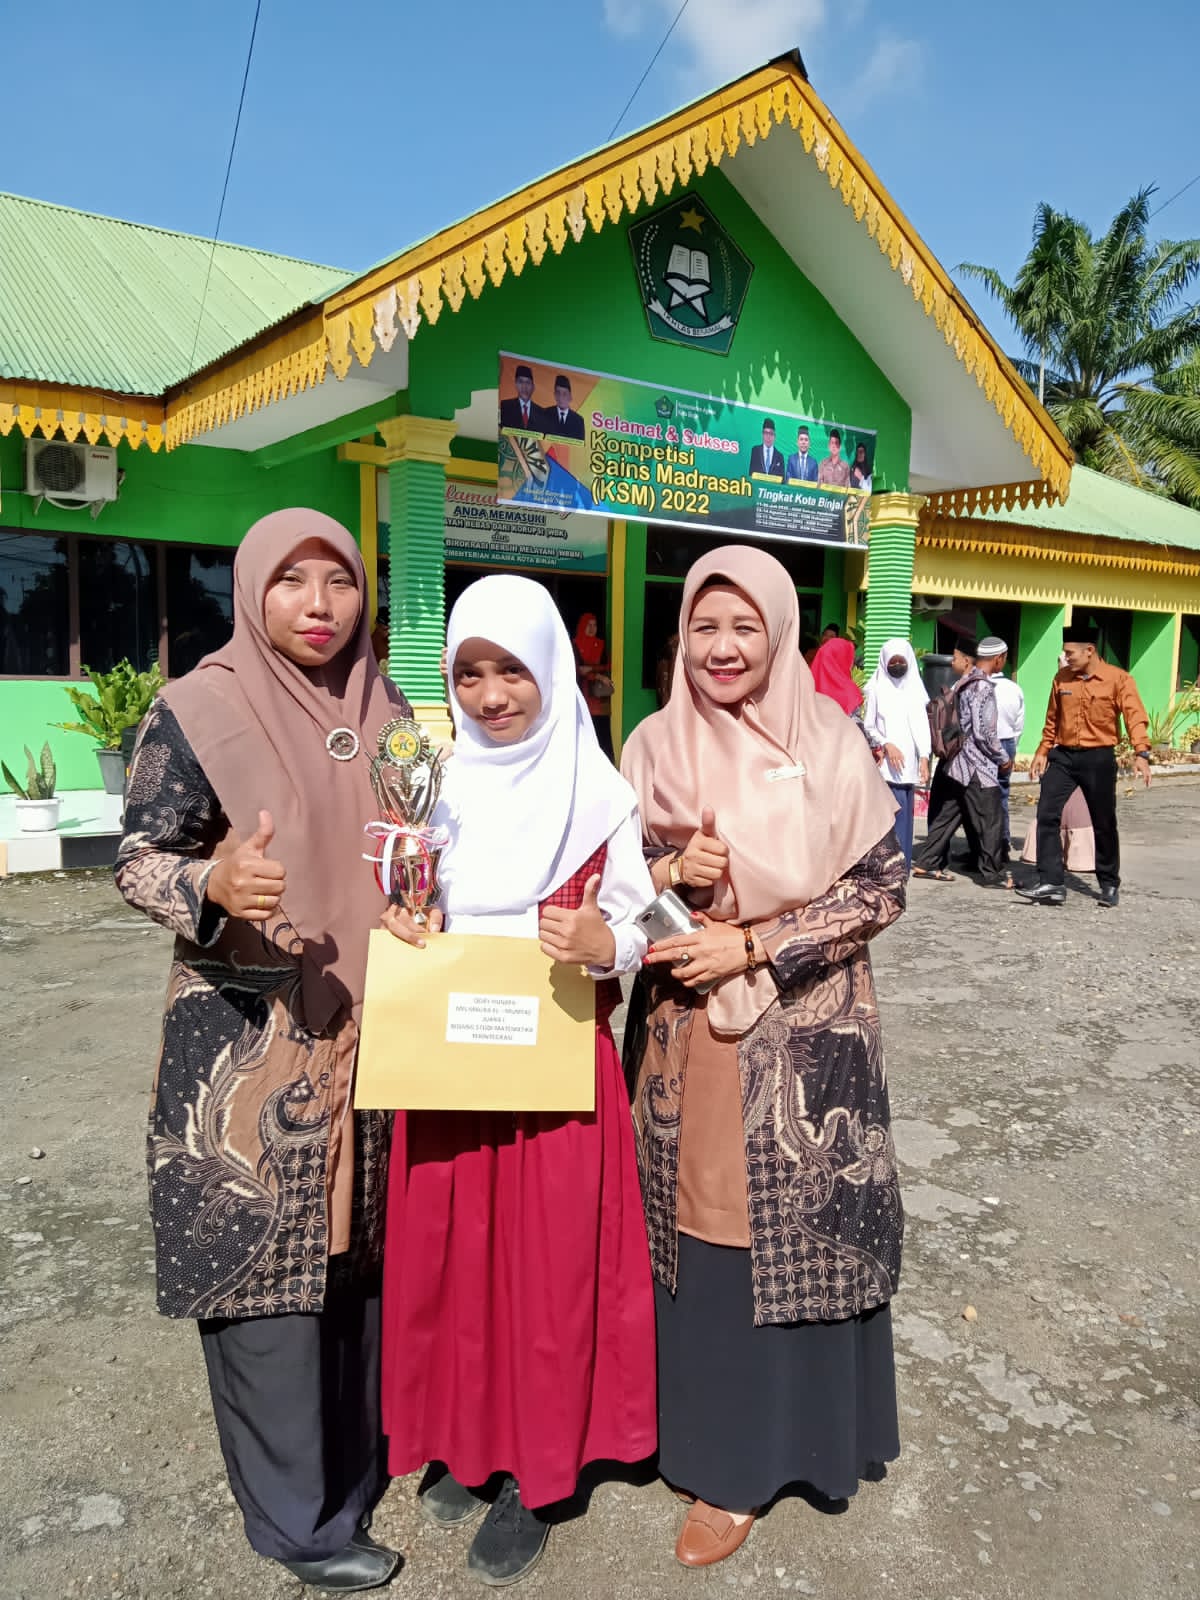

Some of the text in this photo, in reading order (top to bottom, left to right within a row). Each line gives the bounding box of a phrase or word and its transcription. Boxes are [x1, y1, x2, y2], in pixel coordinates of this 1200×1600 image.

[591, 431, 694, 466] Kompetisi
[592, 411, 662, 440] Selamat
[666, 425, 679, 442] &
[682, 428, 739, 453] Sukses
[590, 451, 752, 497] Sains Madrasah
[591, 477, 656, 512] (KSM)
[661, 488, 710, 514] 2022
[758, 488, 793, 503] Tingkat
[795, 493, 816, 506] Kota
[818, 497, 843, 511] Binjai
[453, 505, 488, 518] ANDA
[489, 509, 546, 524] MEMASUKI
[492, 523, 511, 532] DARI
